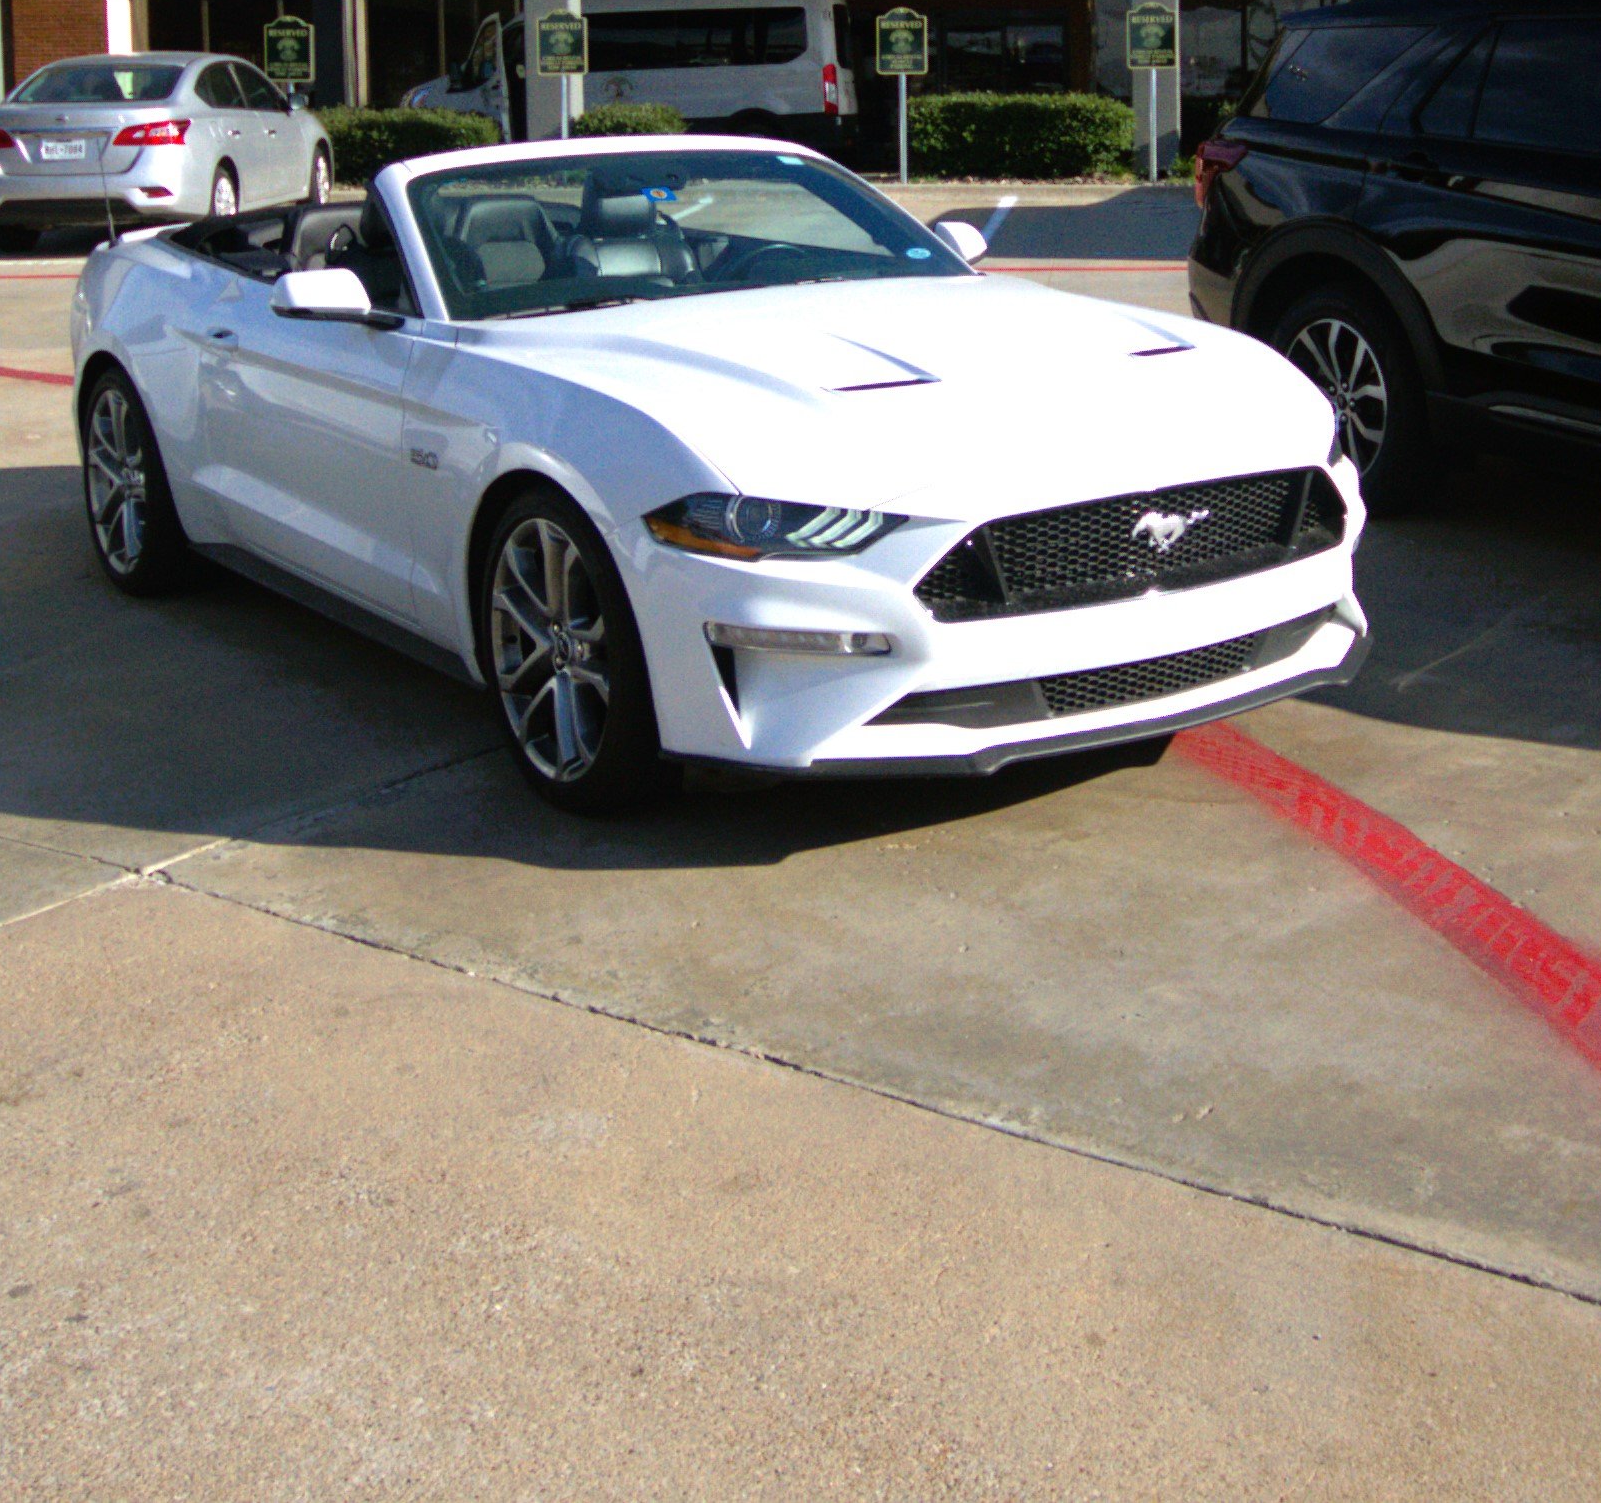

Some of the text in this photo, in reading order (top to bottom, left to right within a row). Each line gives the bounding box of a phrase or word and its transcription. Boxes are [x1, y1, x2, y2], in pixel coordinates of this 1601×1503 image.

[1132, 15, 1173, 24] RESERVED
[540, 22, 582, 31] RESERVED
[880, 20, 922, 30] RESERVED
[268, 28, 308, 37] RESERVED
